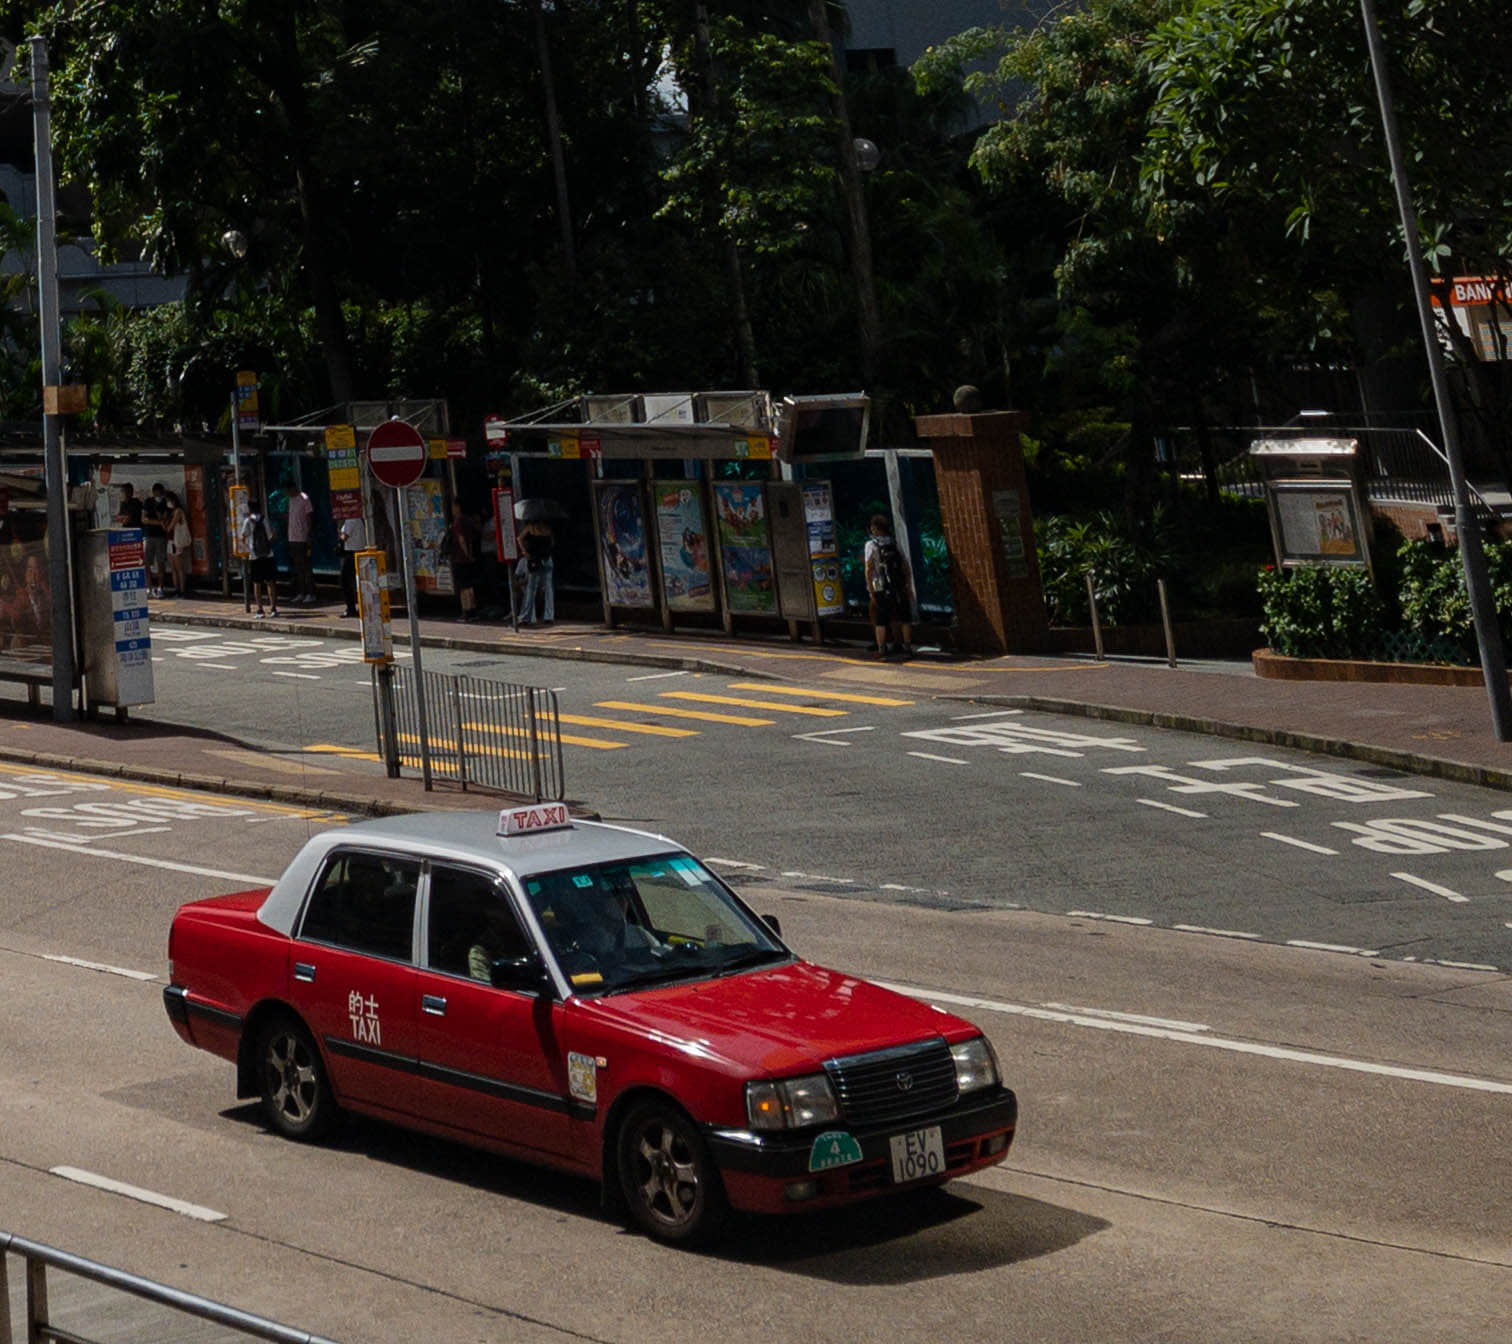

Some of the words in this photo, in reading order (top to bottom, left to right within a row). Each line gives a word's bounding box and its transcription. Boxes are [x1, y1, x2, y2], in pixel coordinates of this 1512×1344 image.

[20, 797, 255, 828] BUS
[513, 805, 566, 830] TAXI
[349, 990, 379, 1020] 的士
[349, 1014, 381, 1046] TAXI
[905, 1129, 927, 1156] EV
[899, 1150, 938, 1182] 1090
